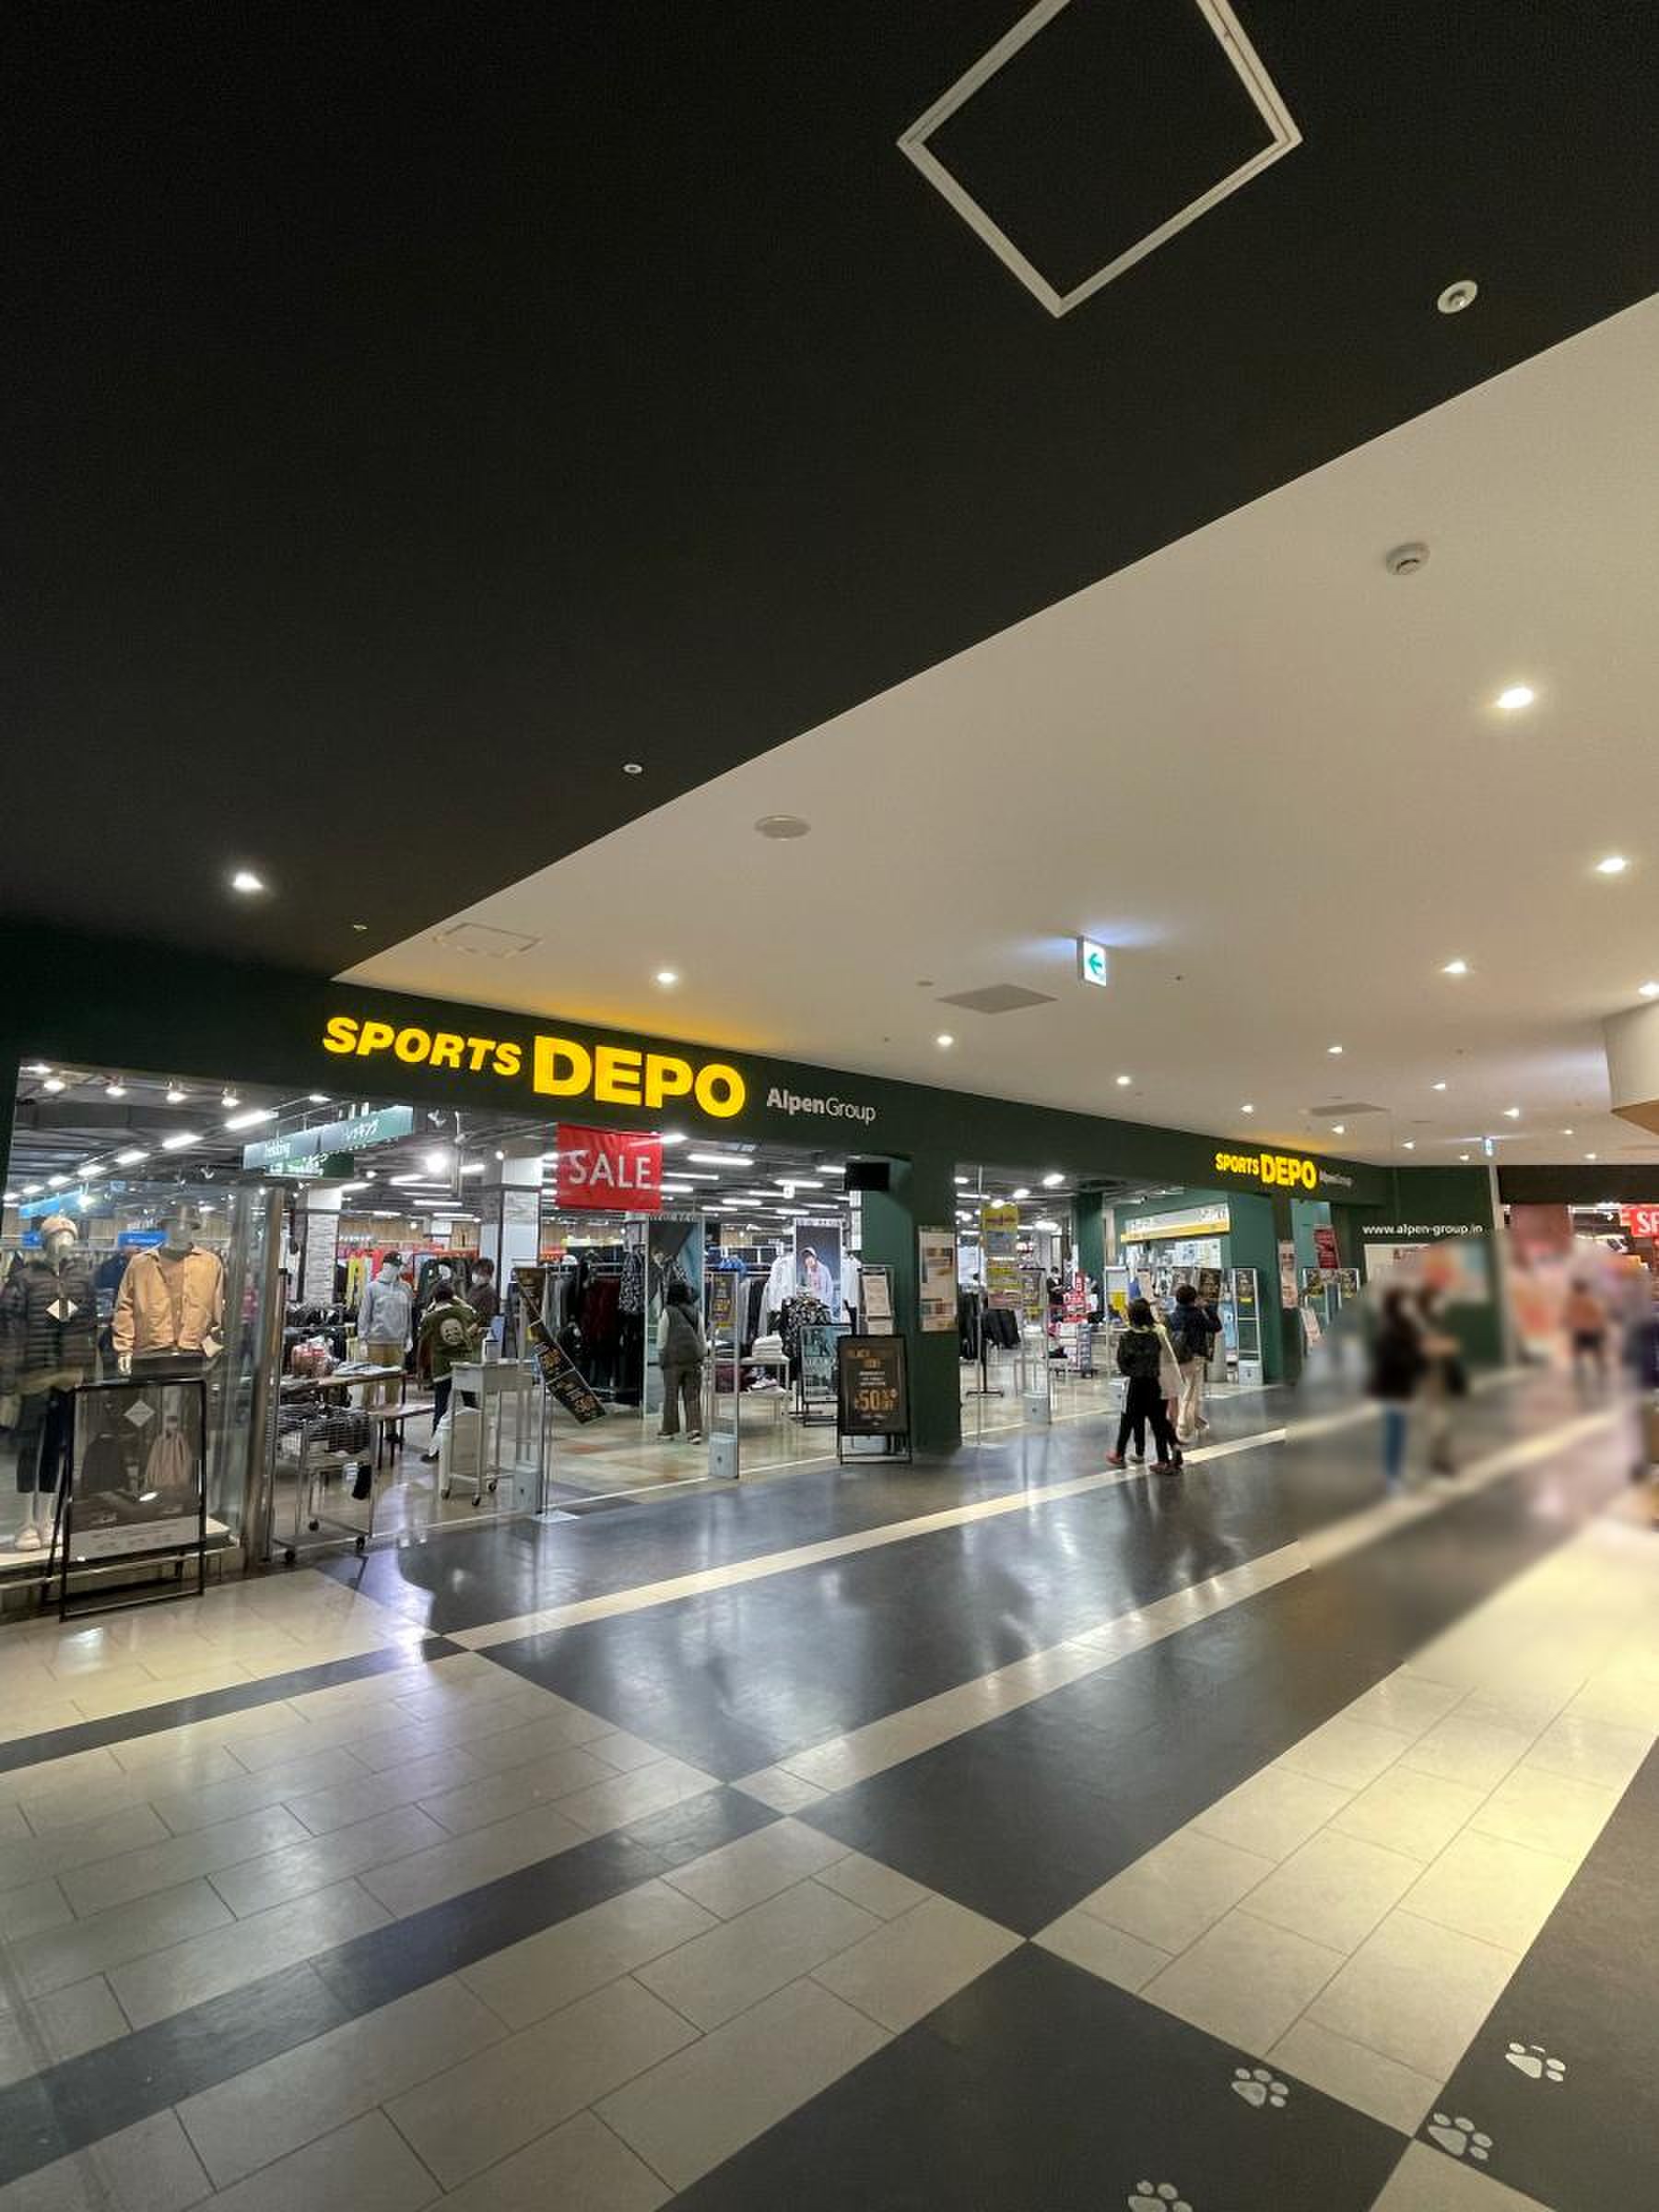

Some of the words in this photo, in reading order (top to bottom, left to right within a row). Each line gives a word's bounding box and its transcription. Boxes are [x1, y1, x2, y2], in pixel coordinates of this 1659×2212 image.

[323, 1017, 523, 1077] SPORTS
[533, 1035, 747, 1118] DEPO
[568, 1152, 653, 1190] SALE
[1215, 1152, 1260, 1176] SPORTS
[1260, 1154, 1317, 1190] DEPO
